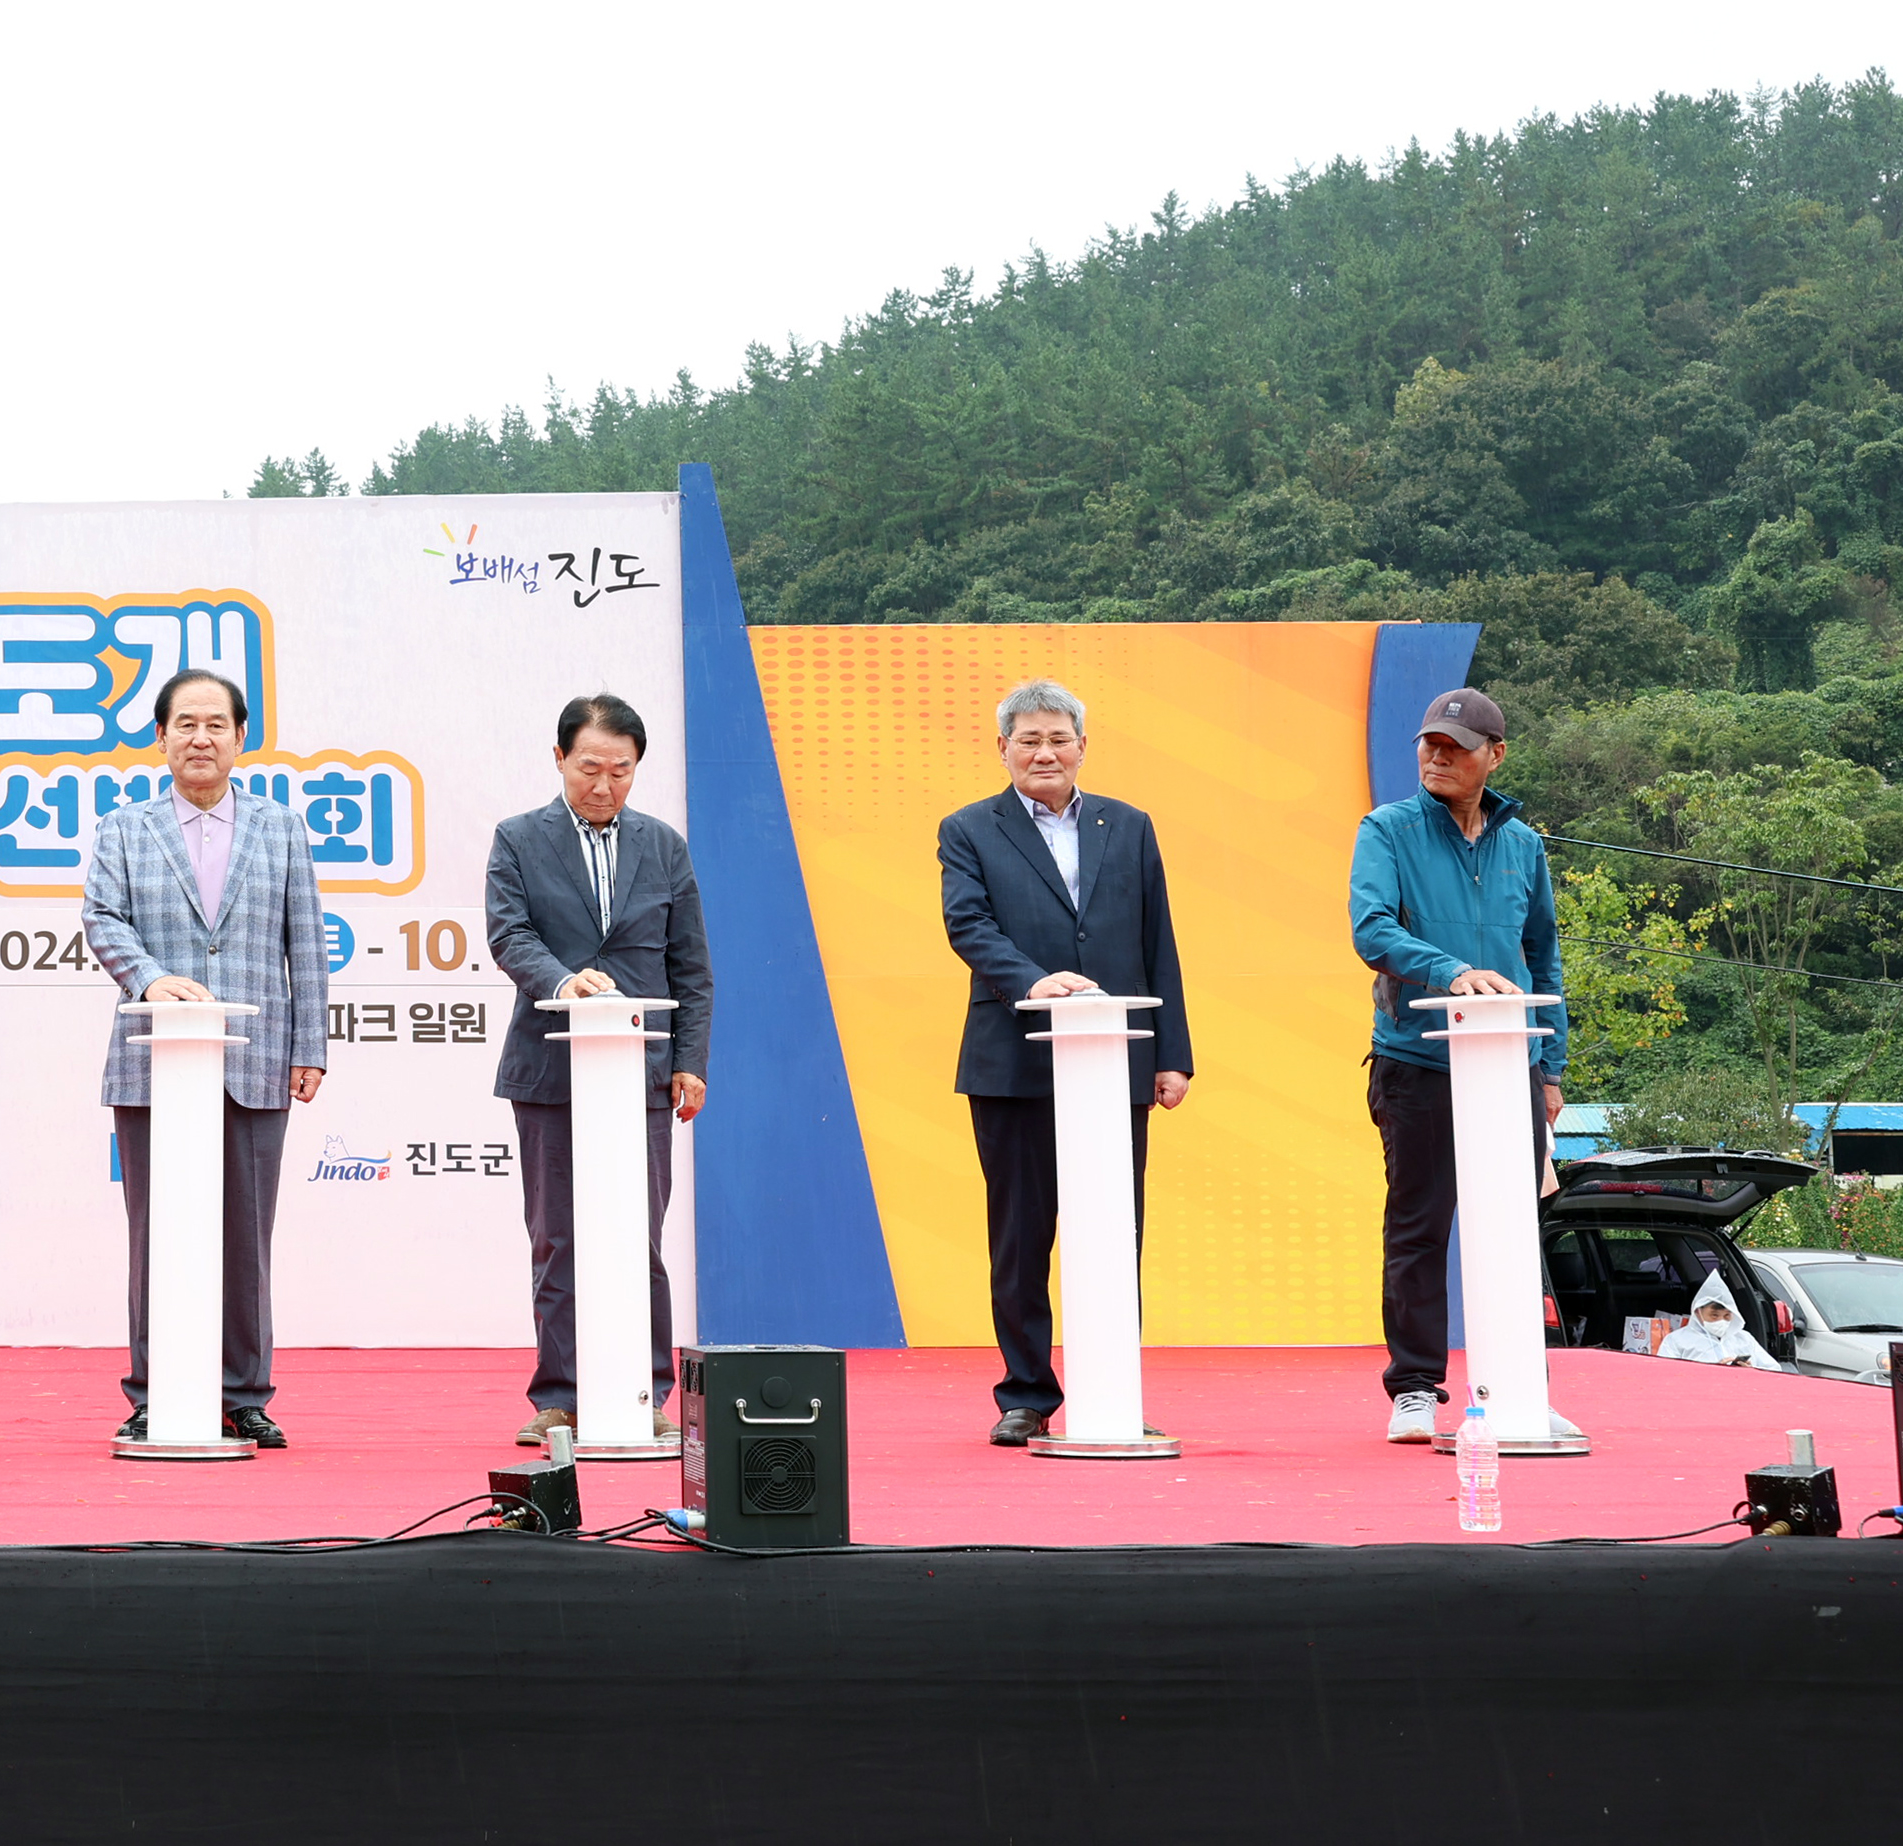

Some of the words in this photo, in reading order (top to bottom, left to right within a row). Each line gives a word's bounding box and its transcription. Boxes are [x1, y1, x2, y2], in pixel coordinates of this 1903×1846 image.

[449, 552, 542, 595] 보배섬
[547, 547, 661, 608] 진도
[409, 1003, 486, 1043] 일원
[307, 1160, 376, 1182] Jindo
[405, 1142, 514, 1176] 진도군
